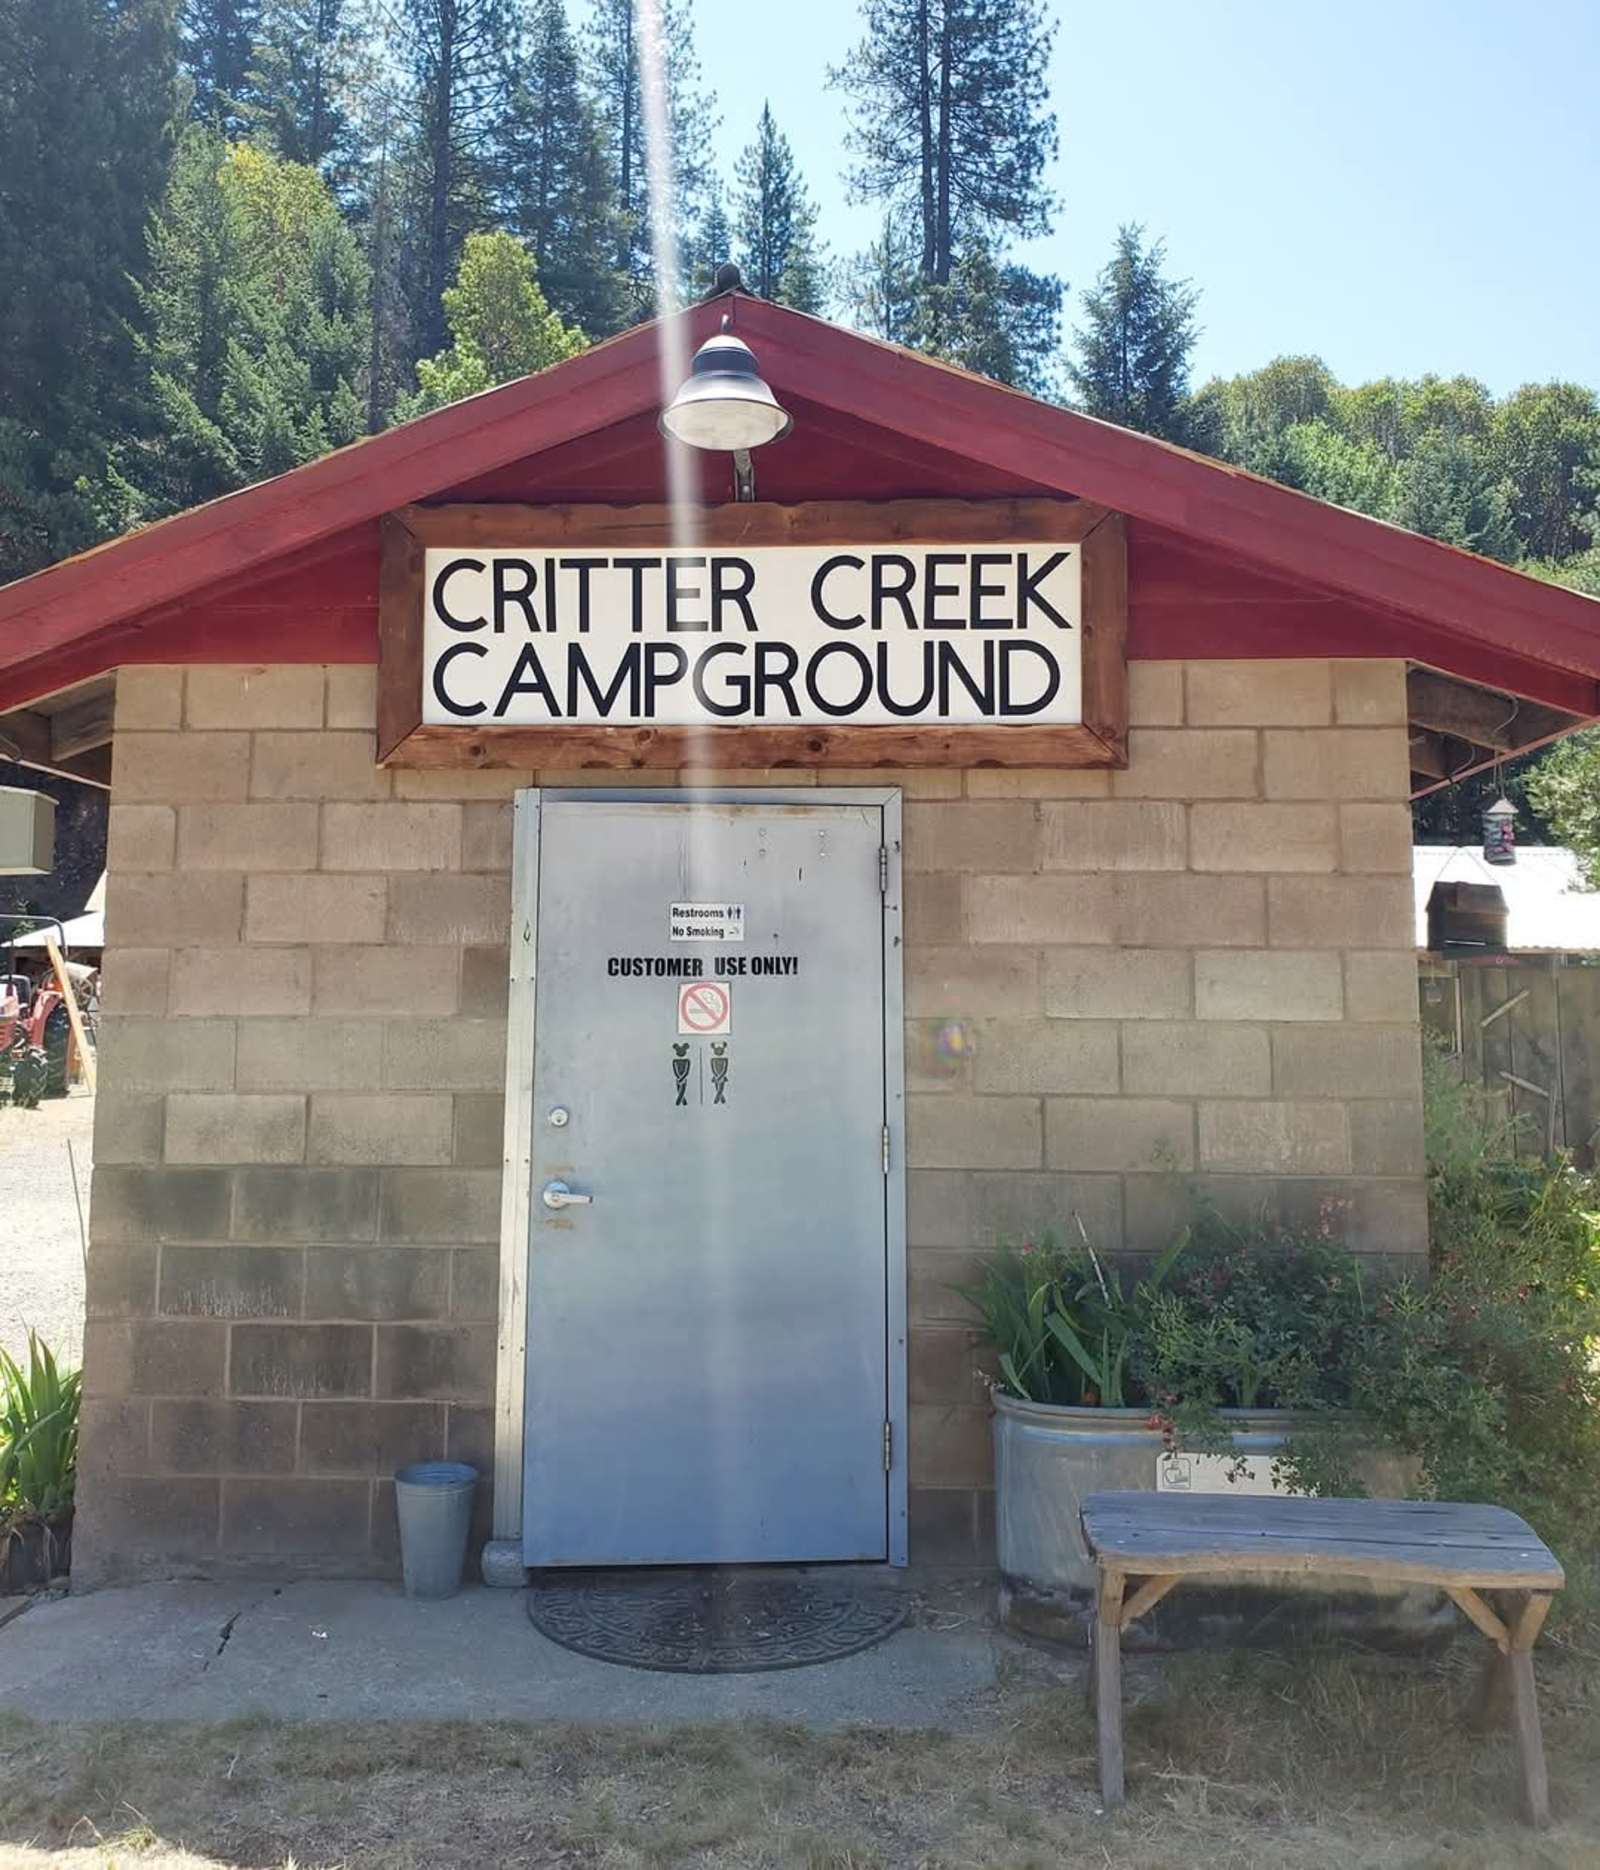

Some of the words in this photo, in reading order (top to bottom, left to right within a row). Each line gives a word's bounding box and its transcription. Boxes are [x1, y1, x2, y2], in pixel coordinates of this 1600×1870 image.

[432, 557, 759, 633] CRITTER
[810, 551, 1073, 630] CREEK
[432, 639, 1061, 718] CAMPGROUND
[672, 907, 725, 919] Restrooms
[672, 926, 684, 937] No
[686, 926, 725, 939] Smoking
[607, 957, 703, 977] CUSTOMER
[714, 956, 747, 976] USE
[751, 956, 798, 976] ONLY!
